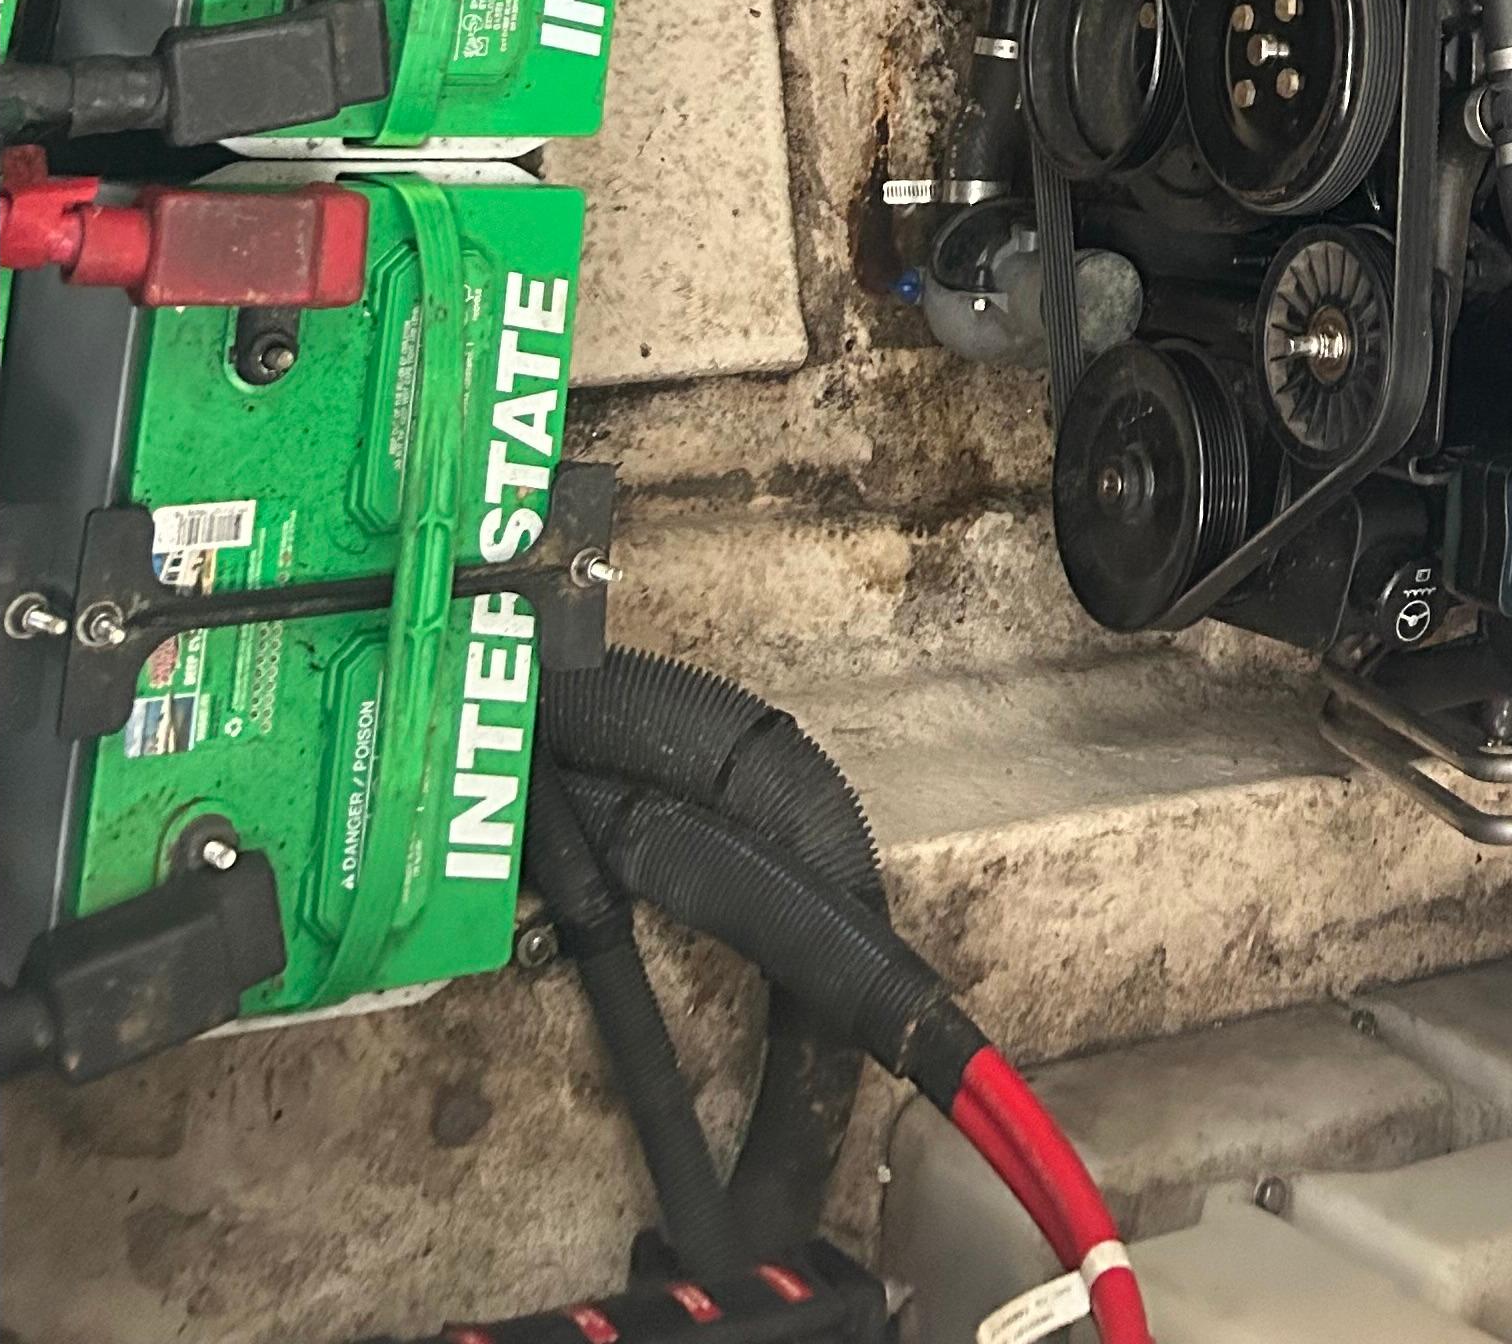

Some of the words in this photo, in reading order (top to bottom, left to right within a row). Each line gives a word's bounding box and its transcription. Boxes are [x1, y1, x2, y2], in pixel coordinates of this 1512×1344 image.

[183, 654, 199, 685] DEEP
[343, 792, 364, 870] DANGER
[354, 700, 375, 771] POISON
